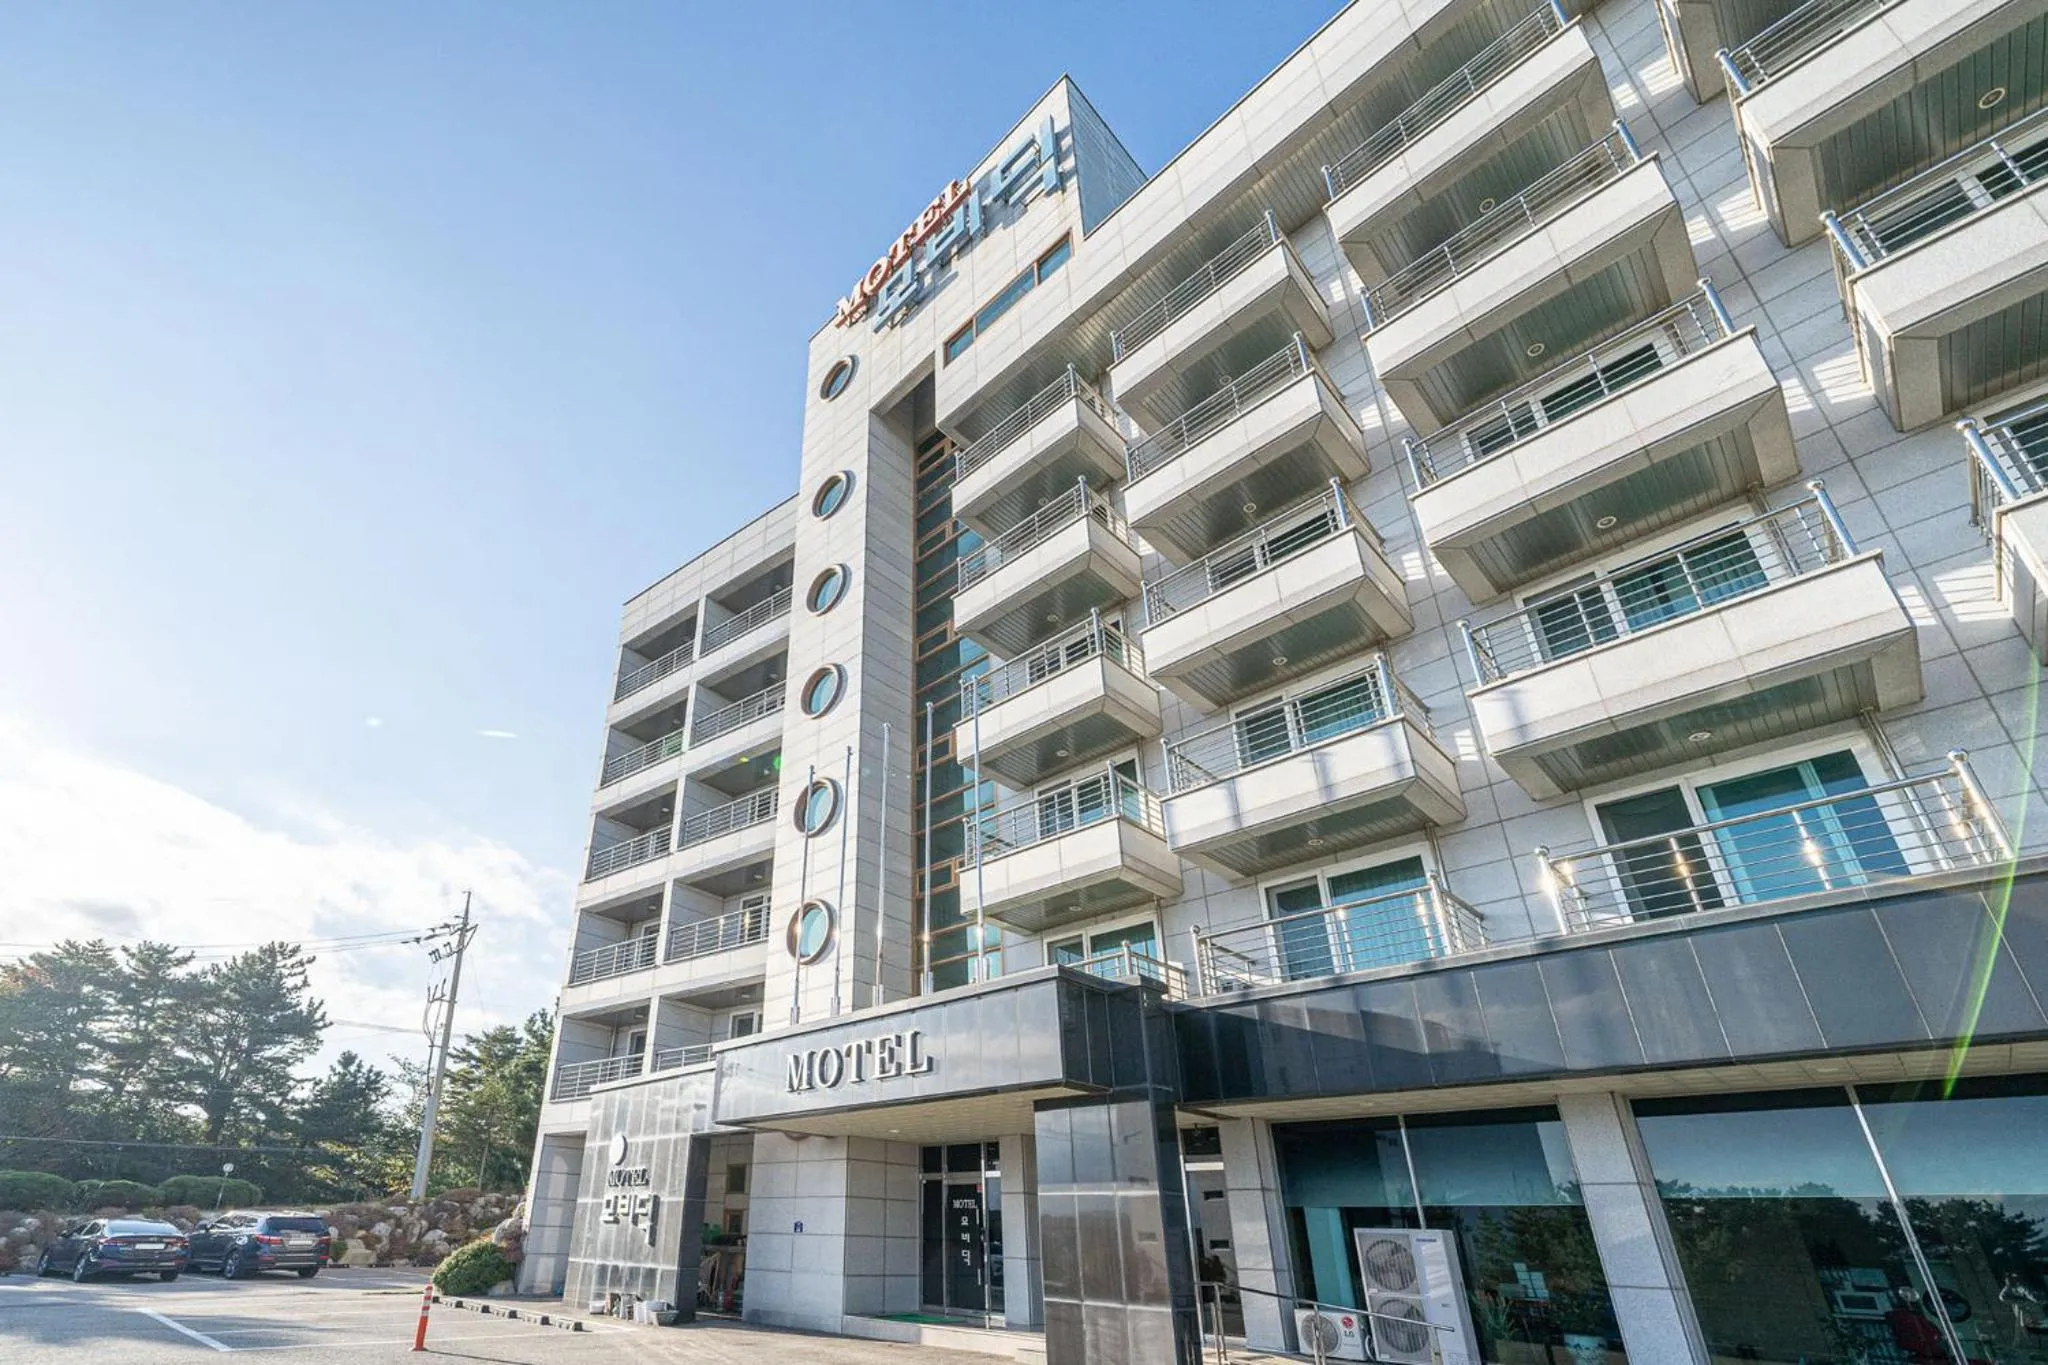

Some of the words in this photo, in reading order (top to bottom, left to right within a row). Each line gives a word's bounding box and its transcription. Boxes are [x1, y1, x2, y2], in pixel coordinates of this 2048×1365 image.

[835, 178, 972, 328] MOTEL
[785, 1030, 934, 1092] MOTEL
[607, 1167, 650, 1187] MOTEL
[952, 1199, 978, 1209] MOTEL
[600, 1193, 660, 1248] 모비딕
